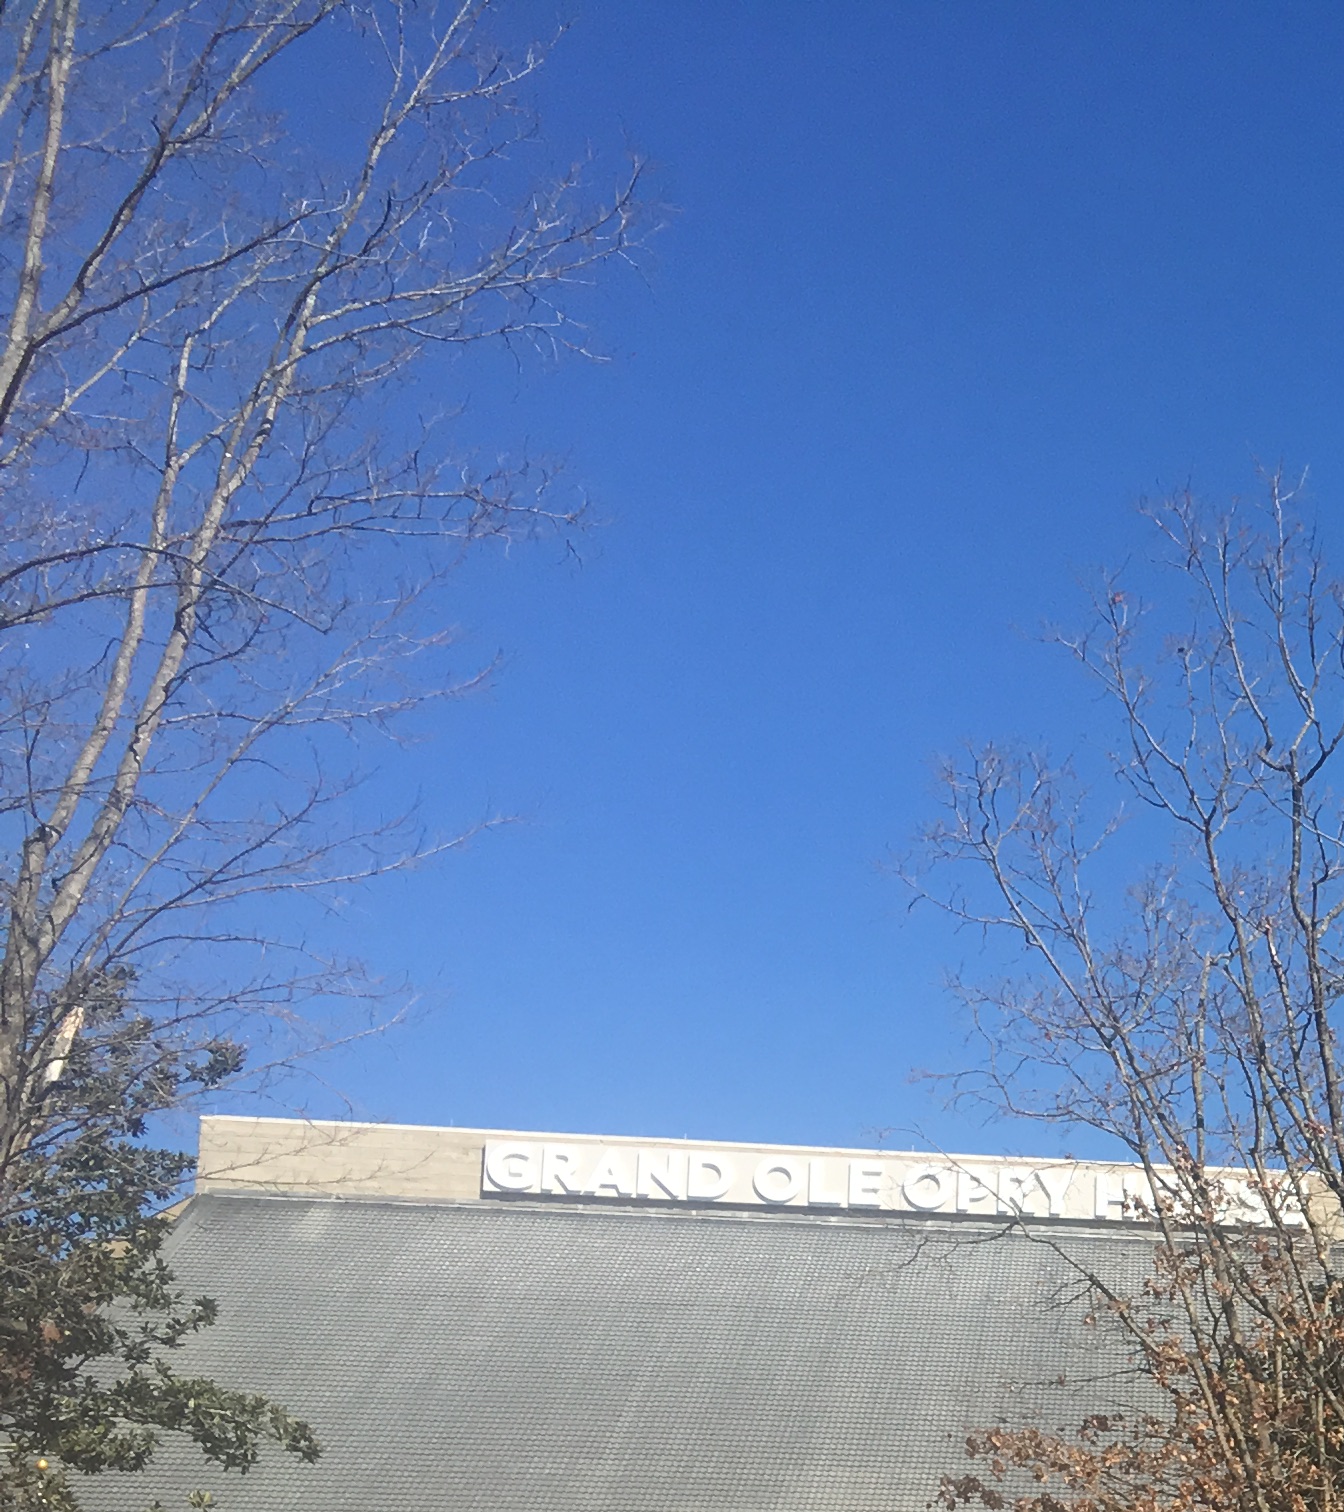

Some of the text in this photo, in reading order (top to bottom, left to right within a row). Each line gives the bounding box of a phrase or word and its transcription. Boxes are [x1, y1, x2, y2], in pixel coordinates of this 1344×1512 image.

[486, 1142, 734, 1200] GRAND
[752, 1156, 886, 1209] OLE
[902, 1166, 1073, 1218] OPRY
